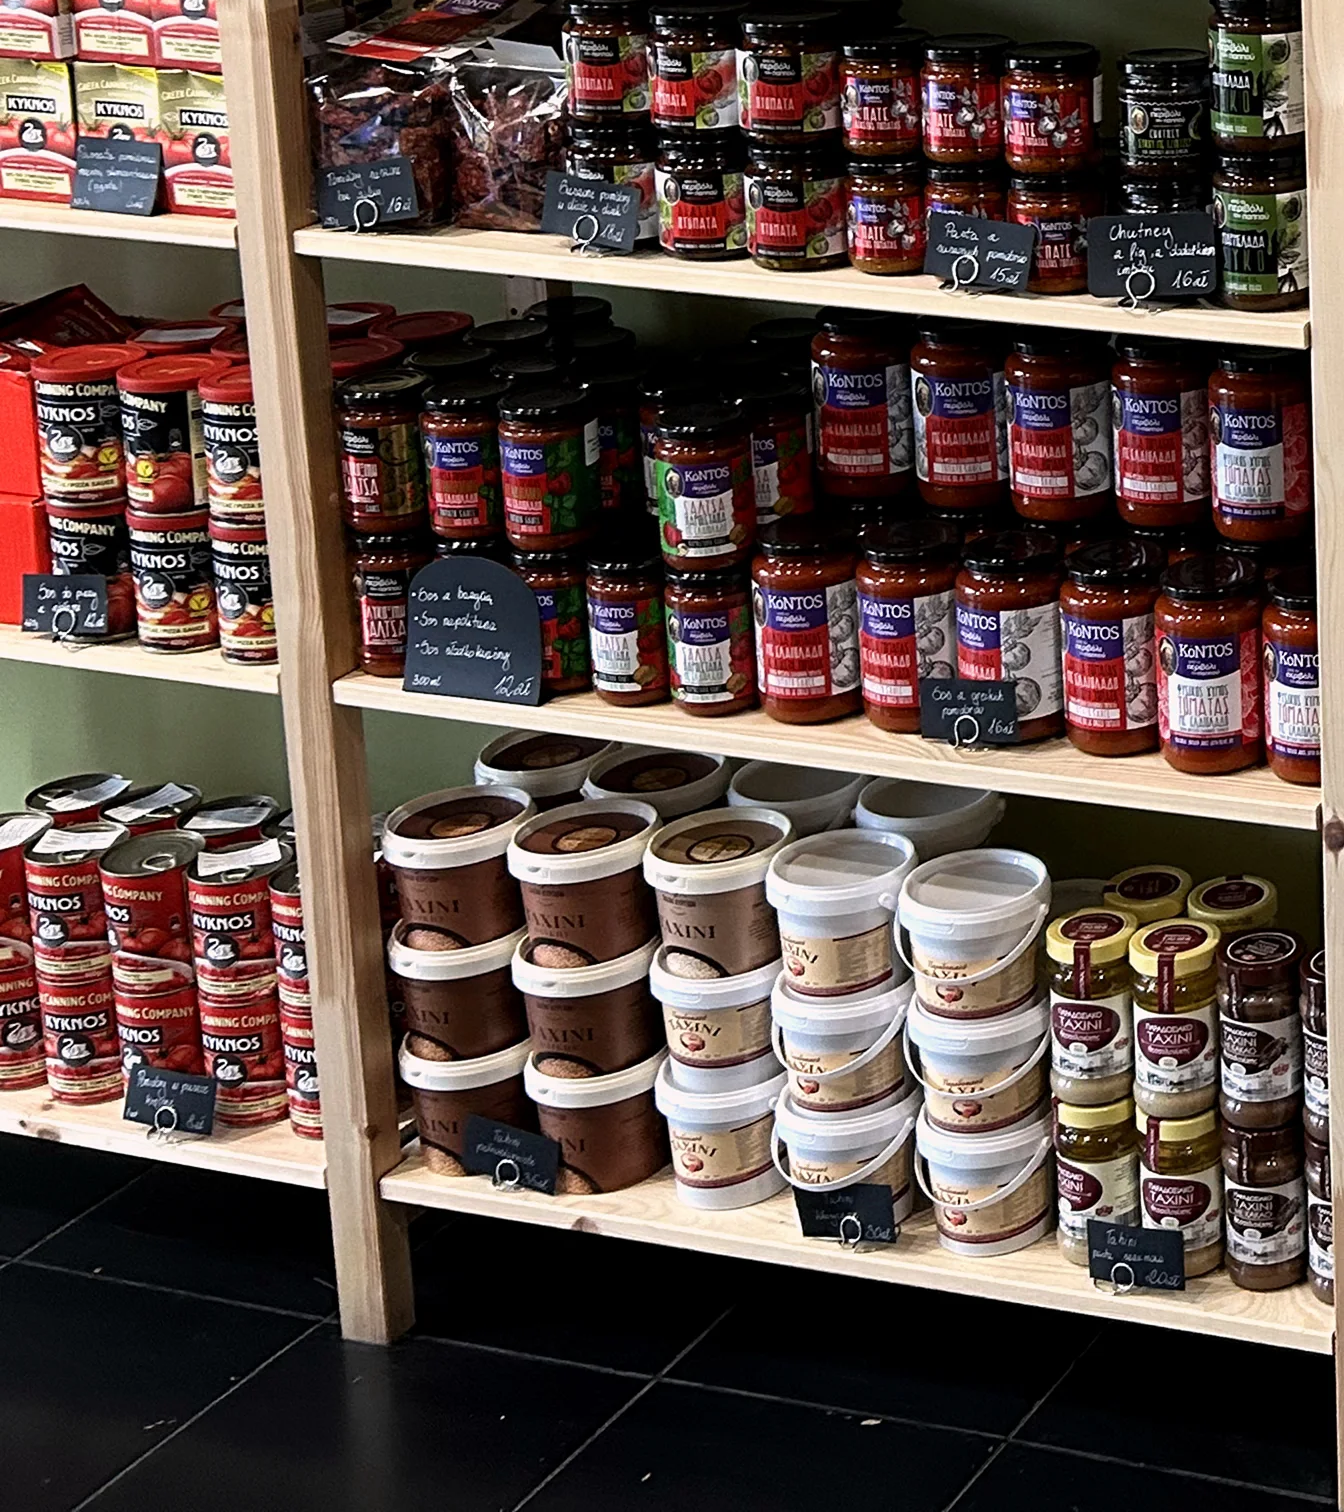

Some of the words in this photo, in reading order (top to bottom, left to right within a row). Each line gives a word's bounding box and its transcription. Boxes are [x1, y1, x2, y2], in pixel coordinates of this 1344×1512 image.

[7, 95, 56, 113] KYKNOS
[95, 102, 145, 119] KYKNOS
[1109, 224, 1176, 251] Chutney
[63, 519, 116, 537] COMPANY
[113, 885, 163, 902] COMPANY
[150, 1005, 194, 1020] COMPANY
